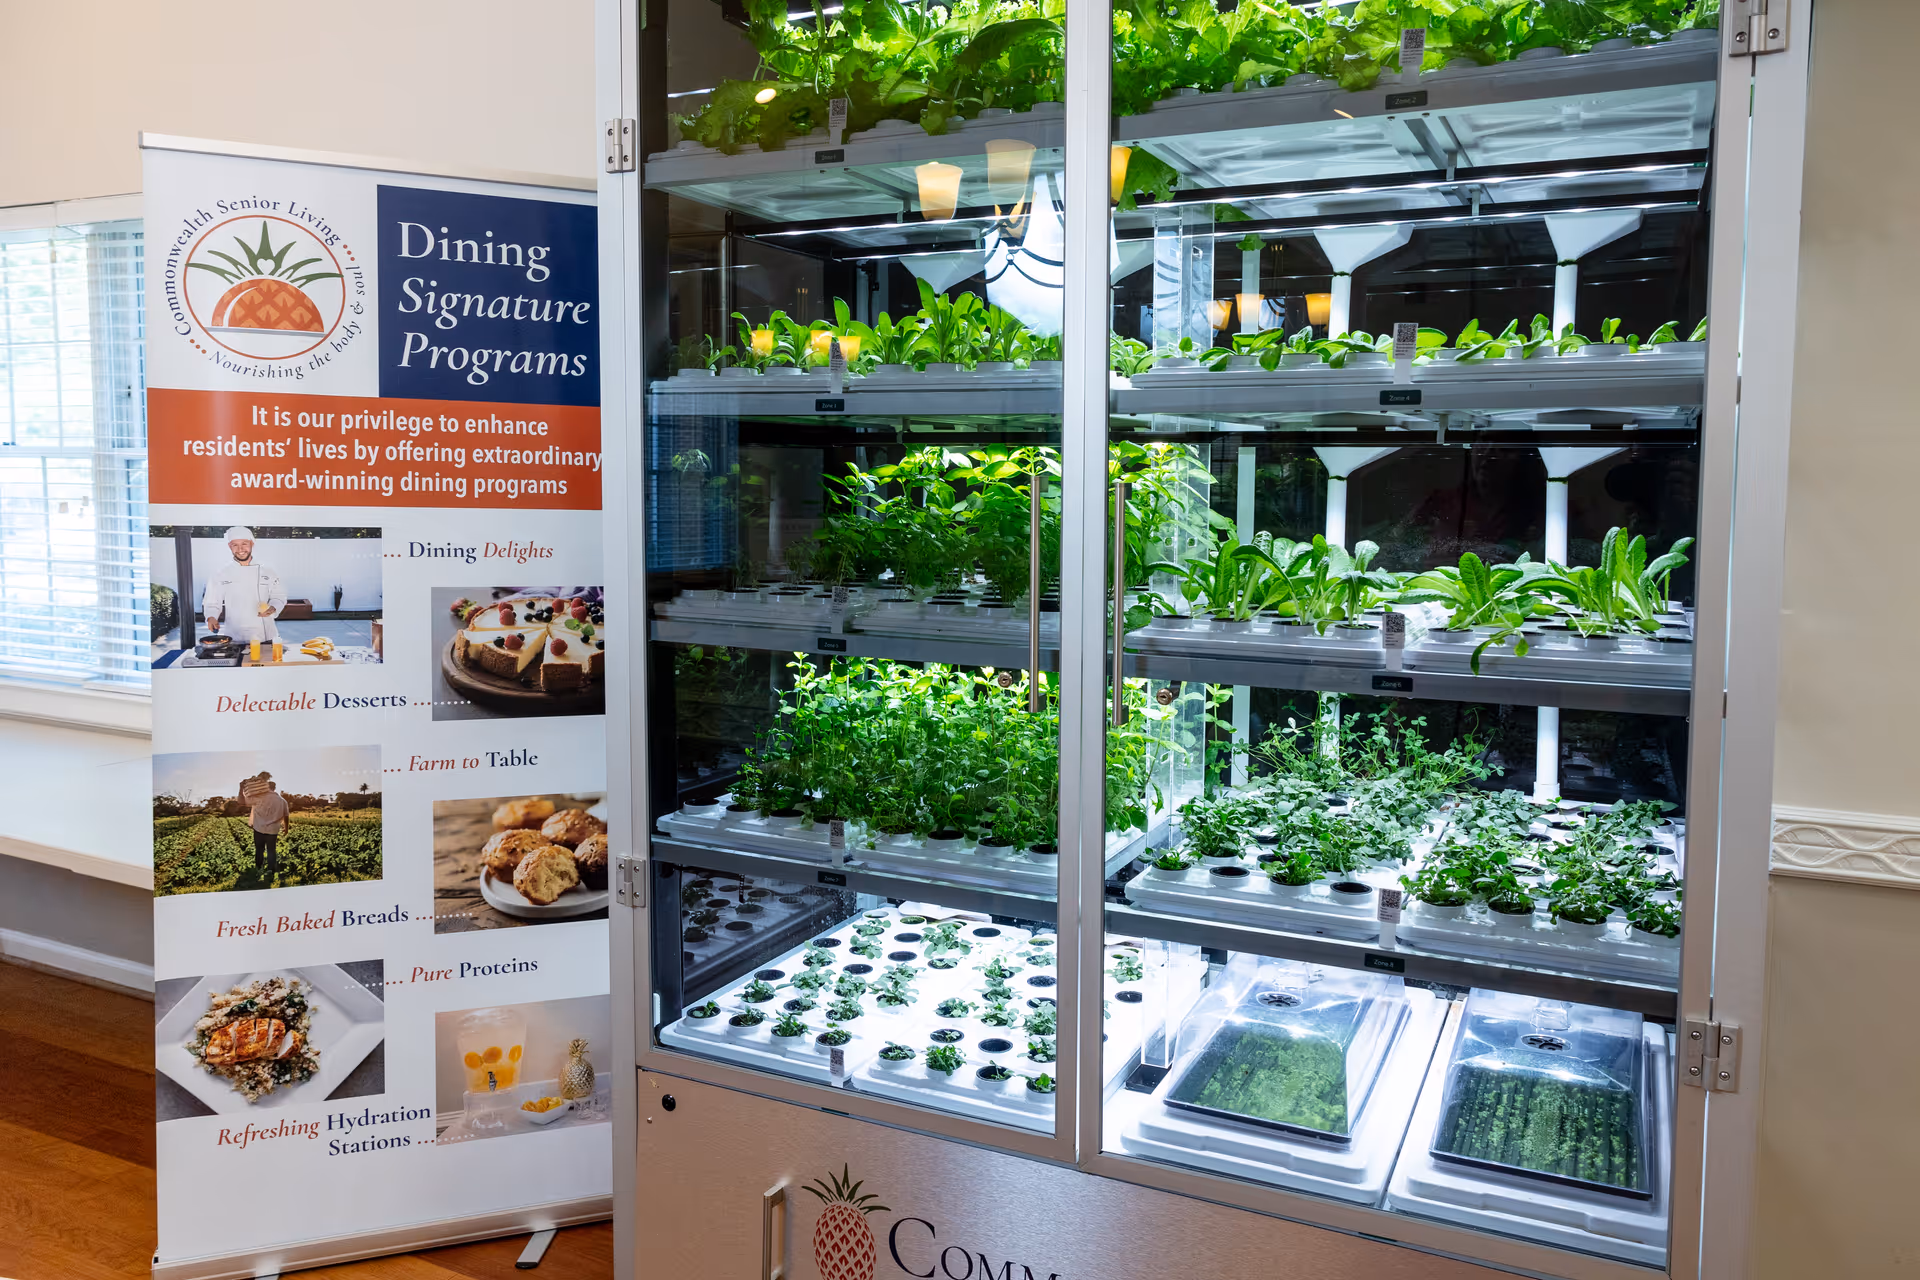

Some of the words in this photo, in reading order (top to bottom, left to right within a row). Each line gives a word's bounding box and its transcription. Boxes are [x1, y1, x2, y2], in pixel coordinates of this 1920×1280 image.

[164, 209, 214, 336] Commonwealth
[216, 195, 281, 215] Senior
[288, 201, 342, 247] Living
[397, 221, 551, 283] Dining
[345, 265, 366, 296] soul
[350, 301, 365, 315] &
[398, 277, 591, 330] Signature
[330, 320, 362, 354] body
[208, 350, 305, 381] Nourishing
[308, 352, 333, 371] the
[397, 331, 588, 386] Programs
[252, 405, 268, 426] It
[274, 406, 292, 427] is
[297, 411, 335, 428] our
[341, 409, 433, 437] privilege
[439, 414, 459, 433] to
[465, 413, 549, 436] enhance
[298, 437, 348, 460] lives
[354, 438, 380, 466] by
[385, 440, 466, 469] offering
[472, 445, 602, 472] extraordinary
[230, 468, 394, 497] award-winning
[400, 471, 467, 498] dining
[474, 476, 568, 499] programs
[408, 541, 477, 565] Dining
[483, 540, 554, 565] Delights
[216, 691, 317, 713] Delectable
[323, 692, 407, 710] Desserts
[408, 755, 456, 772] Farm
[462, 756, 480, 769] to
[485, 749, 539, 768] Table
[216, 916, 268, 938] Fresh
[275, 909, 336, 934] Baked
[341, 904, 409, 927] Breads
[410, 966, 453, 984] Pure
[459, 957, 539, 979] Proteins
[216, 1119, 320, 1150] Refreshing
[326, 1105, 432, 1135] Hydration
[328, 1135, 411, 1157] Stations
